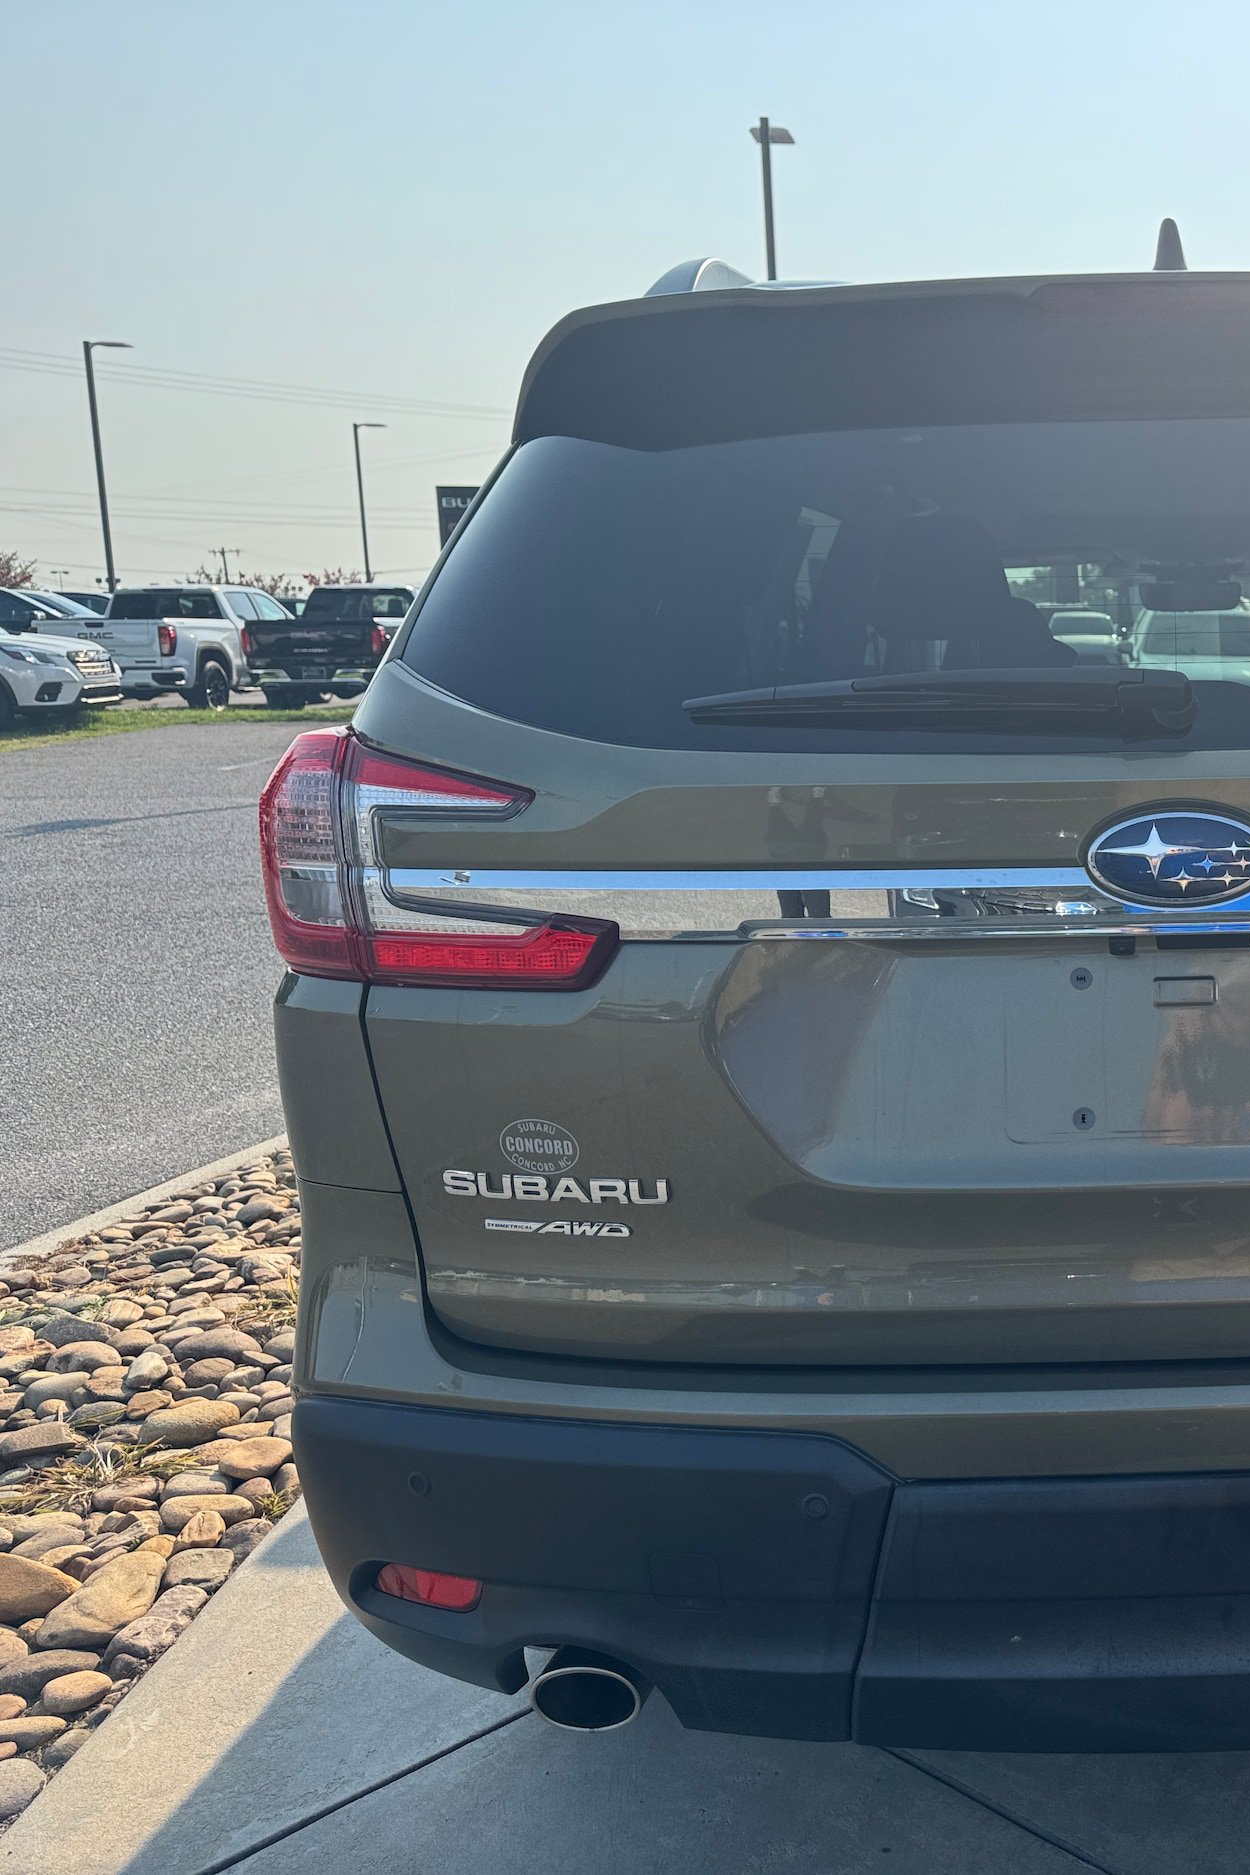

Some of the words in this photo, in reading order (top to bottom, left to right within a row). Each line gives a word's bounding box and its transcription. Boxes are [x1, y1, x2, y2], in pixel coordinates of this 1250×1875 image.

[77, 632, 114, 640] GMC
[517, 1122, 555, 1135] SUBARU
[505, 1136, 573, 1156] CONCORD
[512, 1153, 555, 1172] CONCORD
[558, 1156, 572, 1168] NC
[442, 1169, 668, 1205] SUBARU
[487, 1222, 534, 1230] SYMMETRICAL
[537, 1220, 631, 1237] AWD
